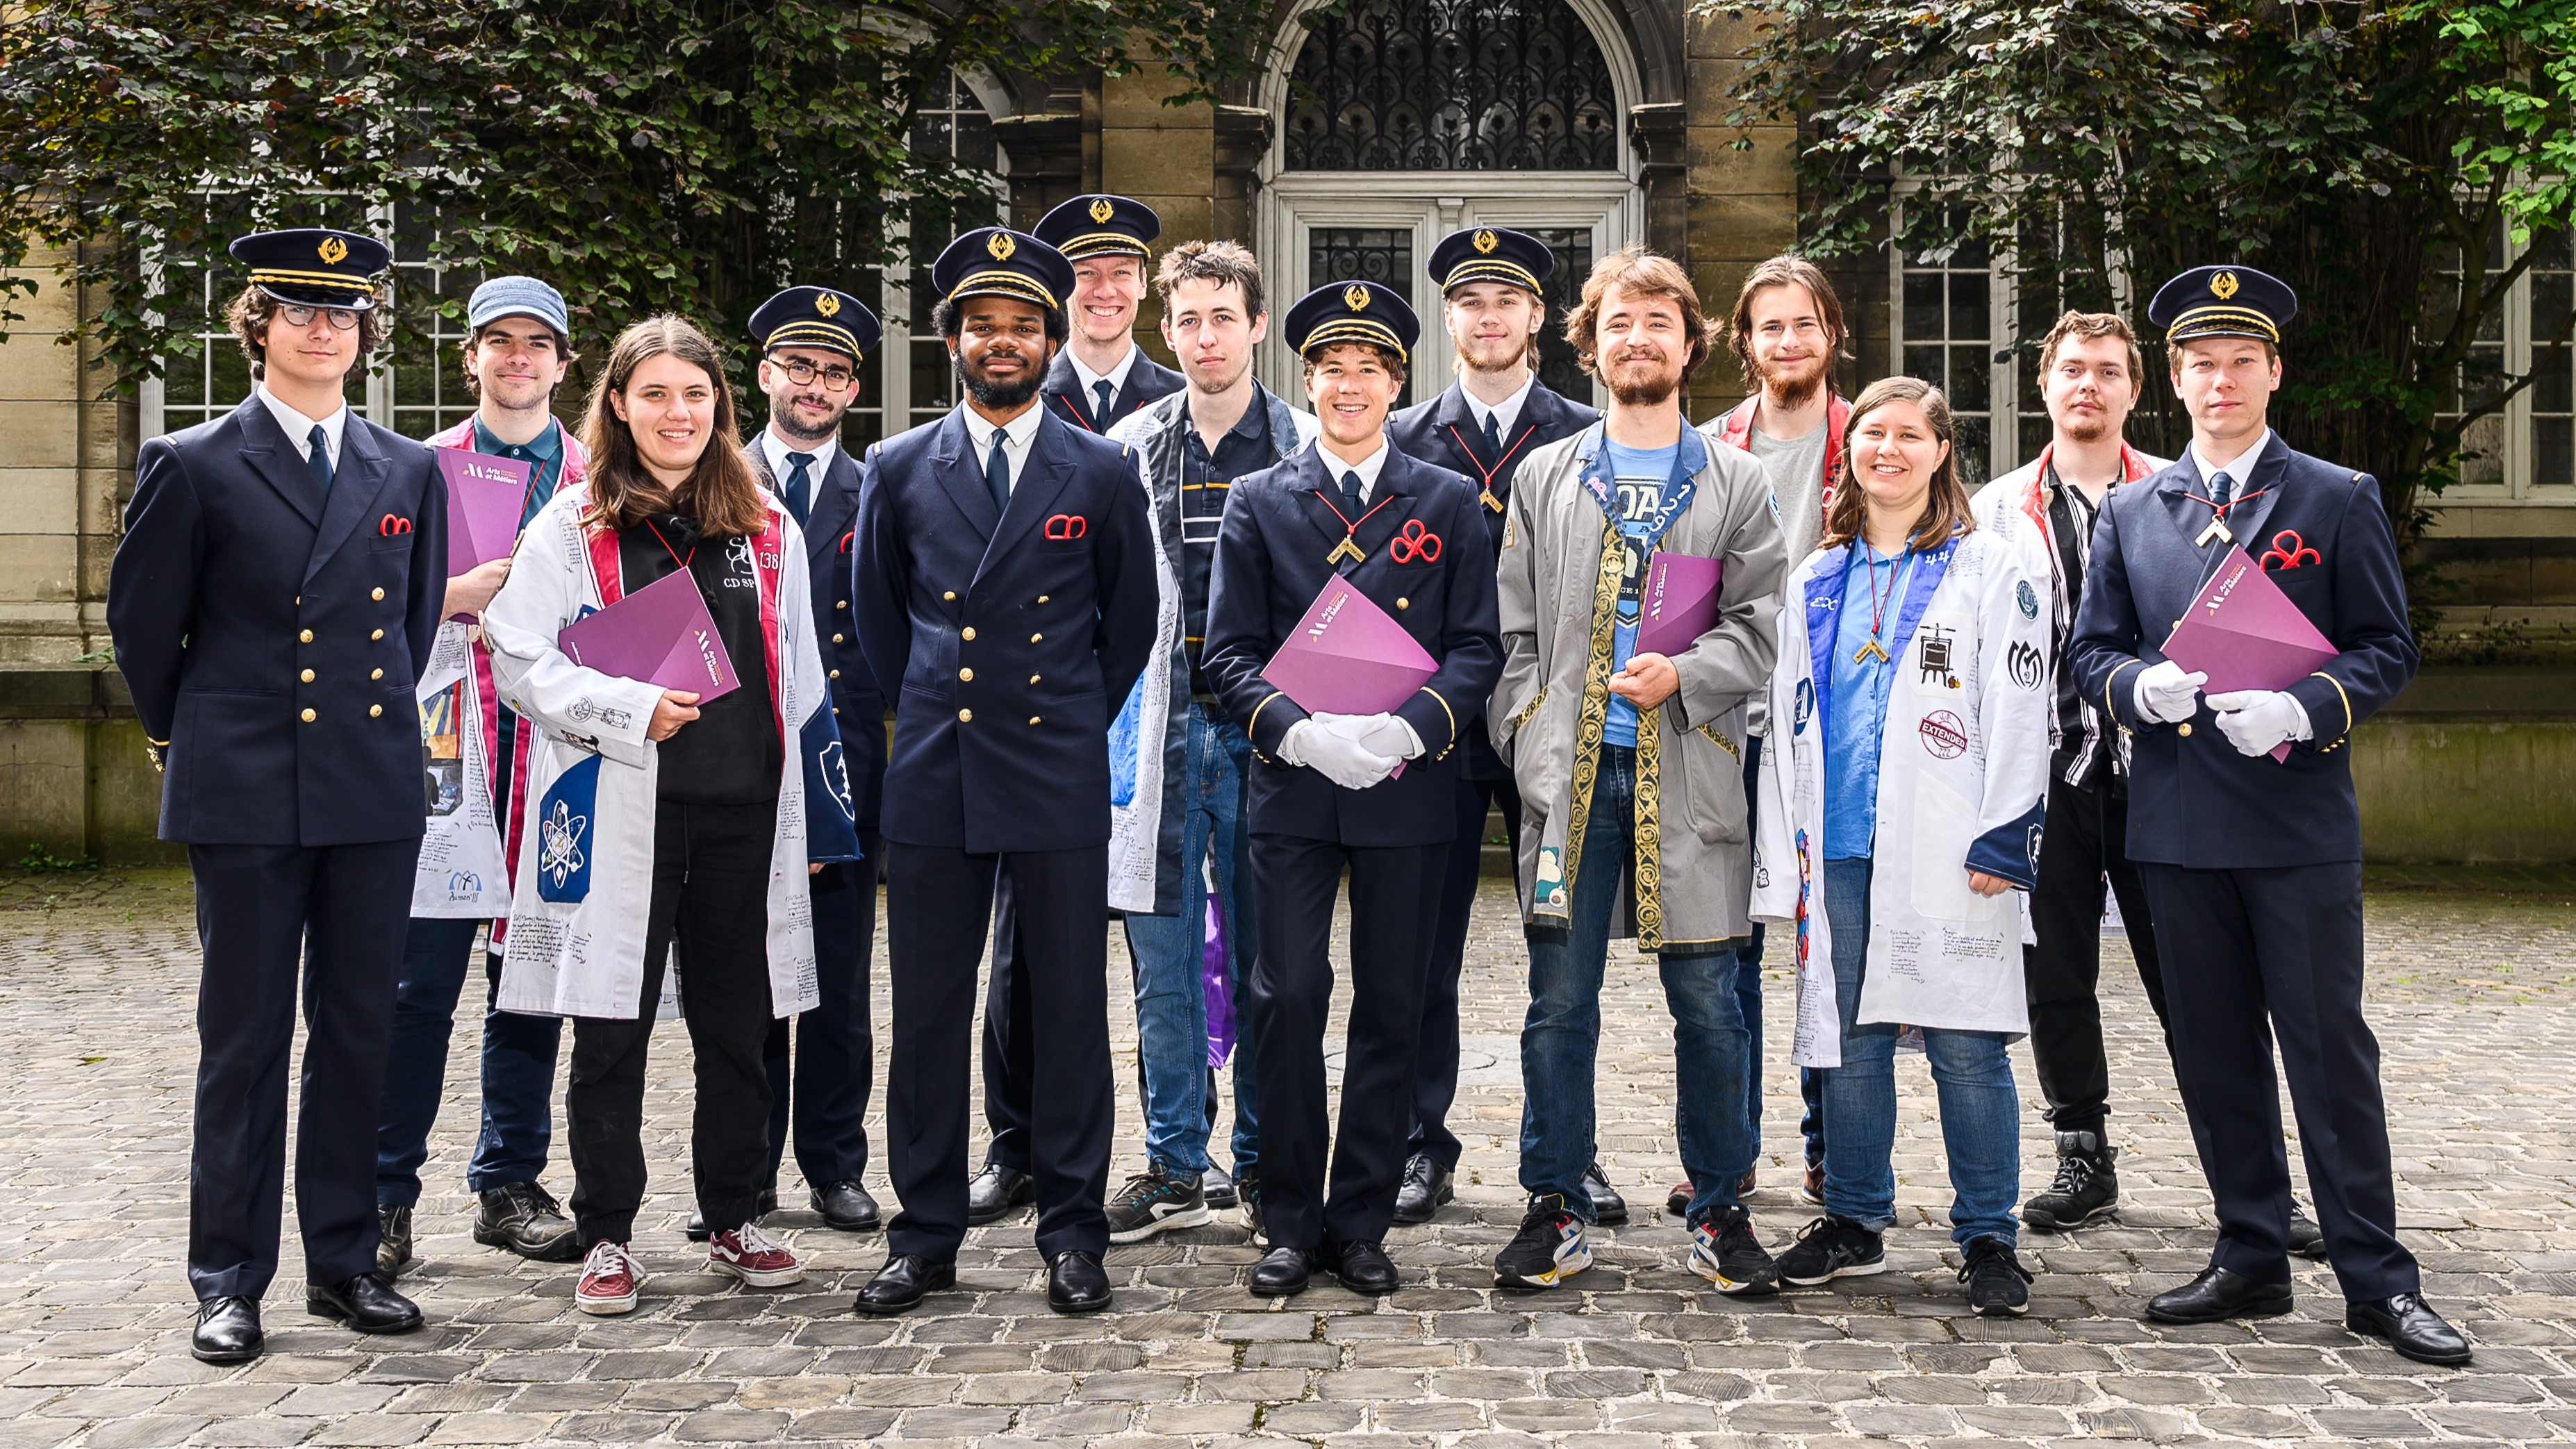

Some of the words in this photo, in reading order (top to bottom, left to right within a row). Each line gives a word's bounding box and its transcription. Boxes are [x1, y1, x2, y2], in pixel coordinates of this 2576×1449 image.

[486, 467, 500, 475] Arts
[759, 551, 779, 570] 138
[723, 578, 741, 588] CD
[2219, 578, 2231, 593] Arts
[1321, 605, 1332, 620] Arts
[708, 650, 717, 665] Arts
[1922, 722, 1965, 748] EXTENDED
